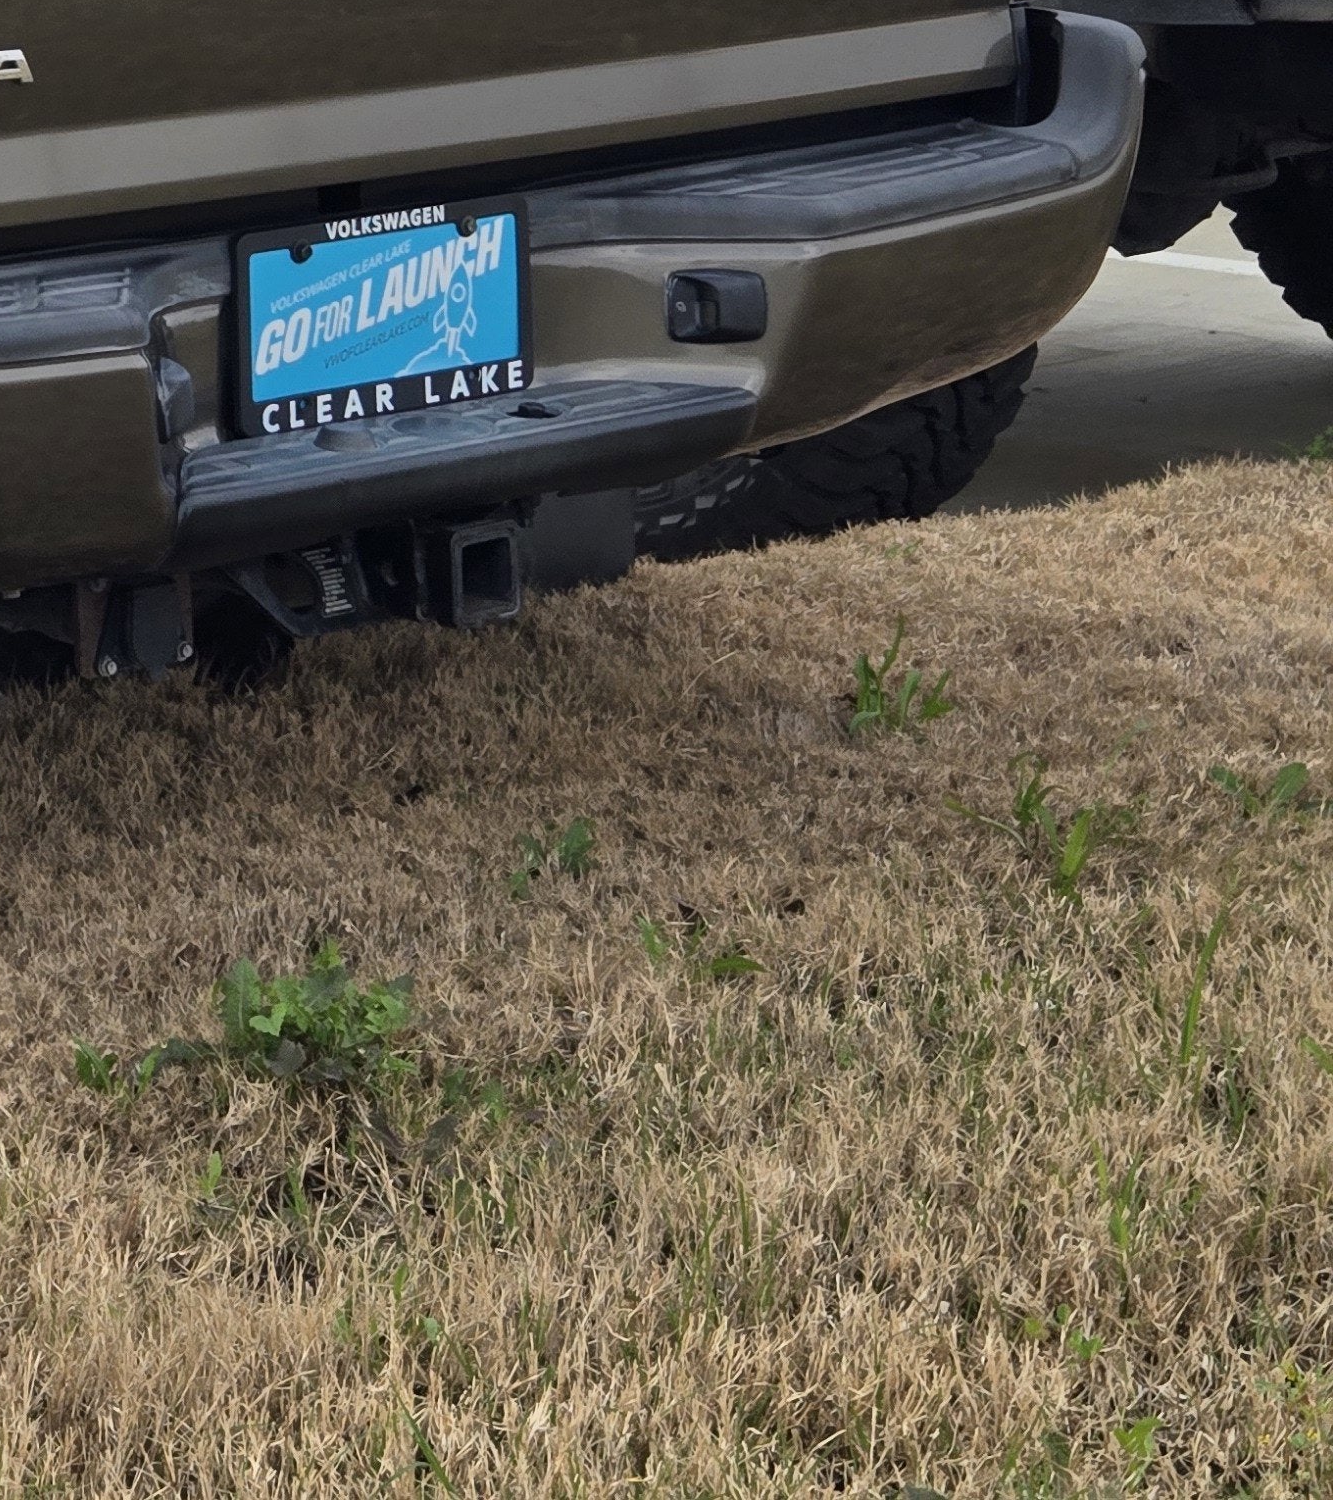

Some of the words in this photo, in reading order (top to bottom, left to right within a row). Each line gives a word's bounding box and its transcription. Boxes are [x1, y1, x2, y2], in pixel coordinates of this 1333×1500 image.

[325, 204, 446, 240] VOLKSWAGEN
[255, 307, 312, 376] GO
[312, 294, 354, 348] FOR
[356, 217, 504, 333] LAUNCH
[270, 269, 348, 314] VOLKSWAGEN
[349, 252, 383, 279] CLEAR
[385, 238, 412, 262] LAKE
[262, 382, 395, 433] CLEAR
[425, 360, 524, 404] LAKE
